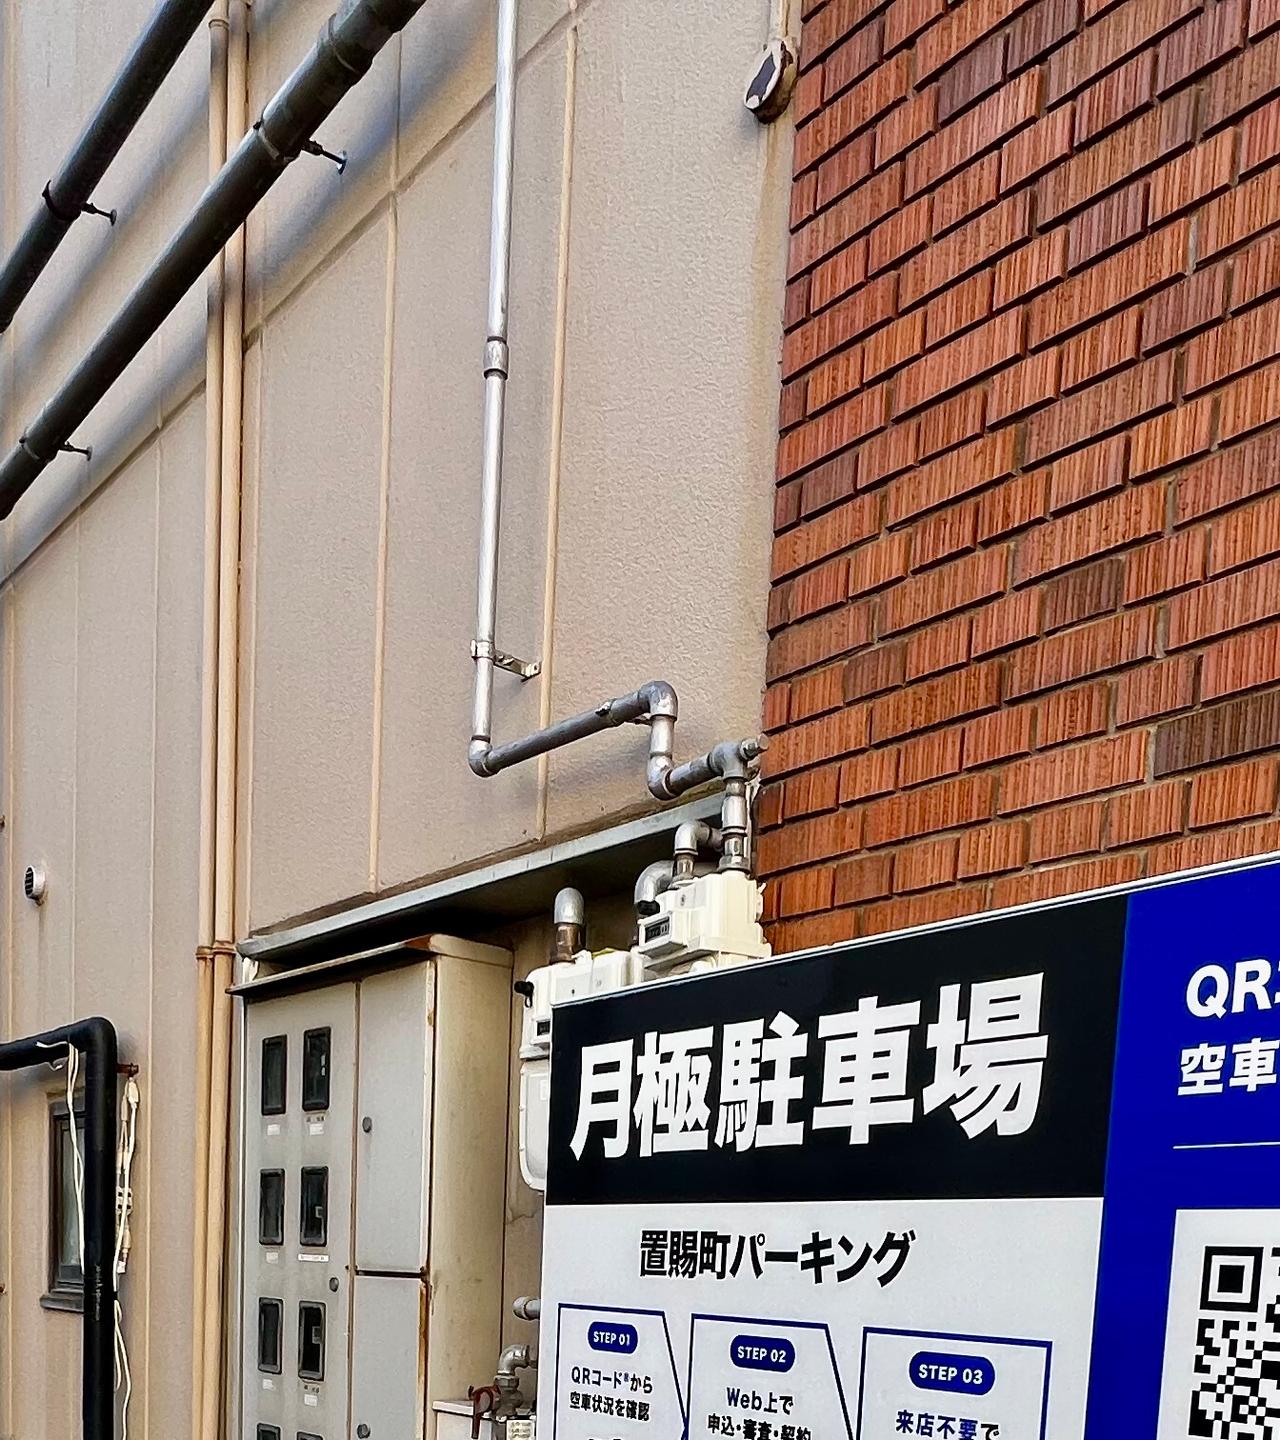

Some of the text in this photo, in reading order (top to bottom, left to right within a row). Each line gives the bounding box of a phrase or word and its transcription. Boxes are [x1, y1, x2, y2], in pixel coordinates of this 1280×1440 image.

[570, 973, 1048, 1160] 月極駐車場
[639, 1229, 917, 1287] 置賜町パーキング
[593, 1330, 632, 1346] STEP 01
[736, 1346, 787, 1363] STEP 02
[917, 1363, 984, 1385] STEP 03
[569, 1391, 651, 1421] 空車状況を確認
[726, 1387, 794, 1415] Web上で
